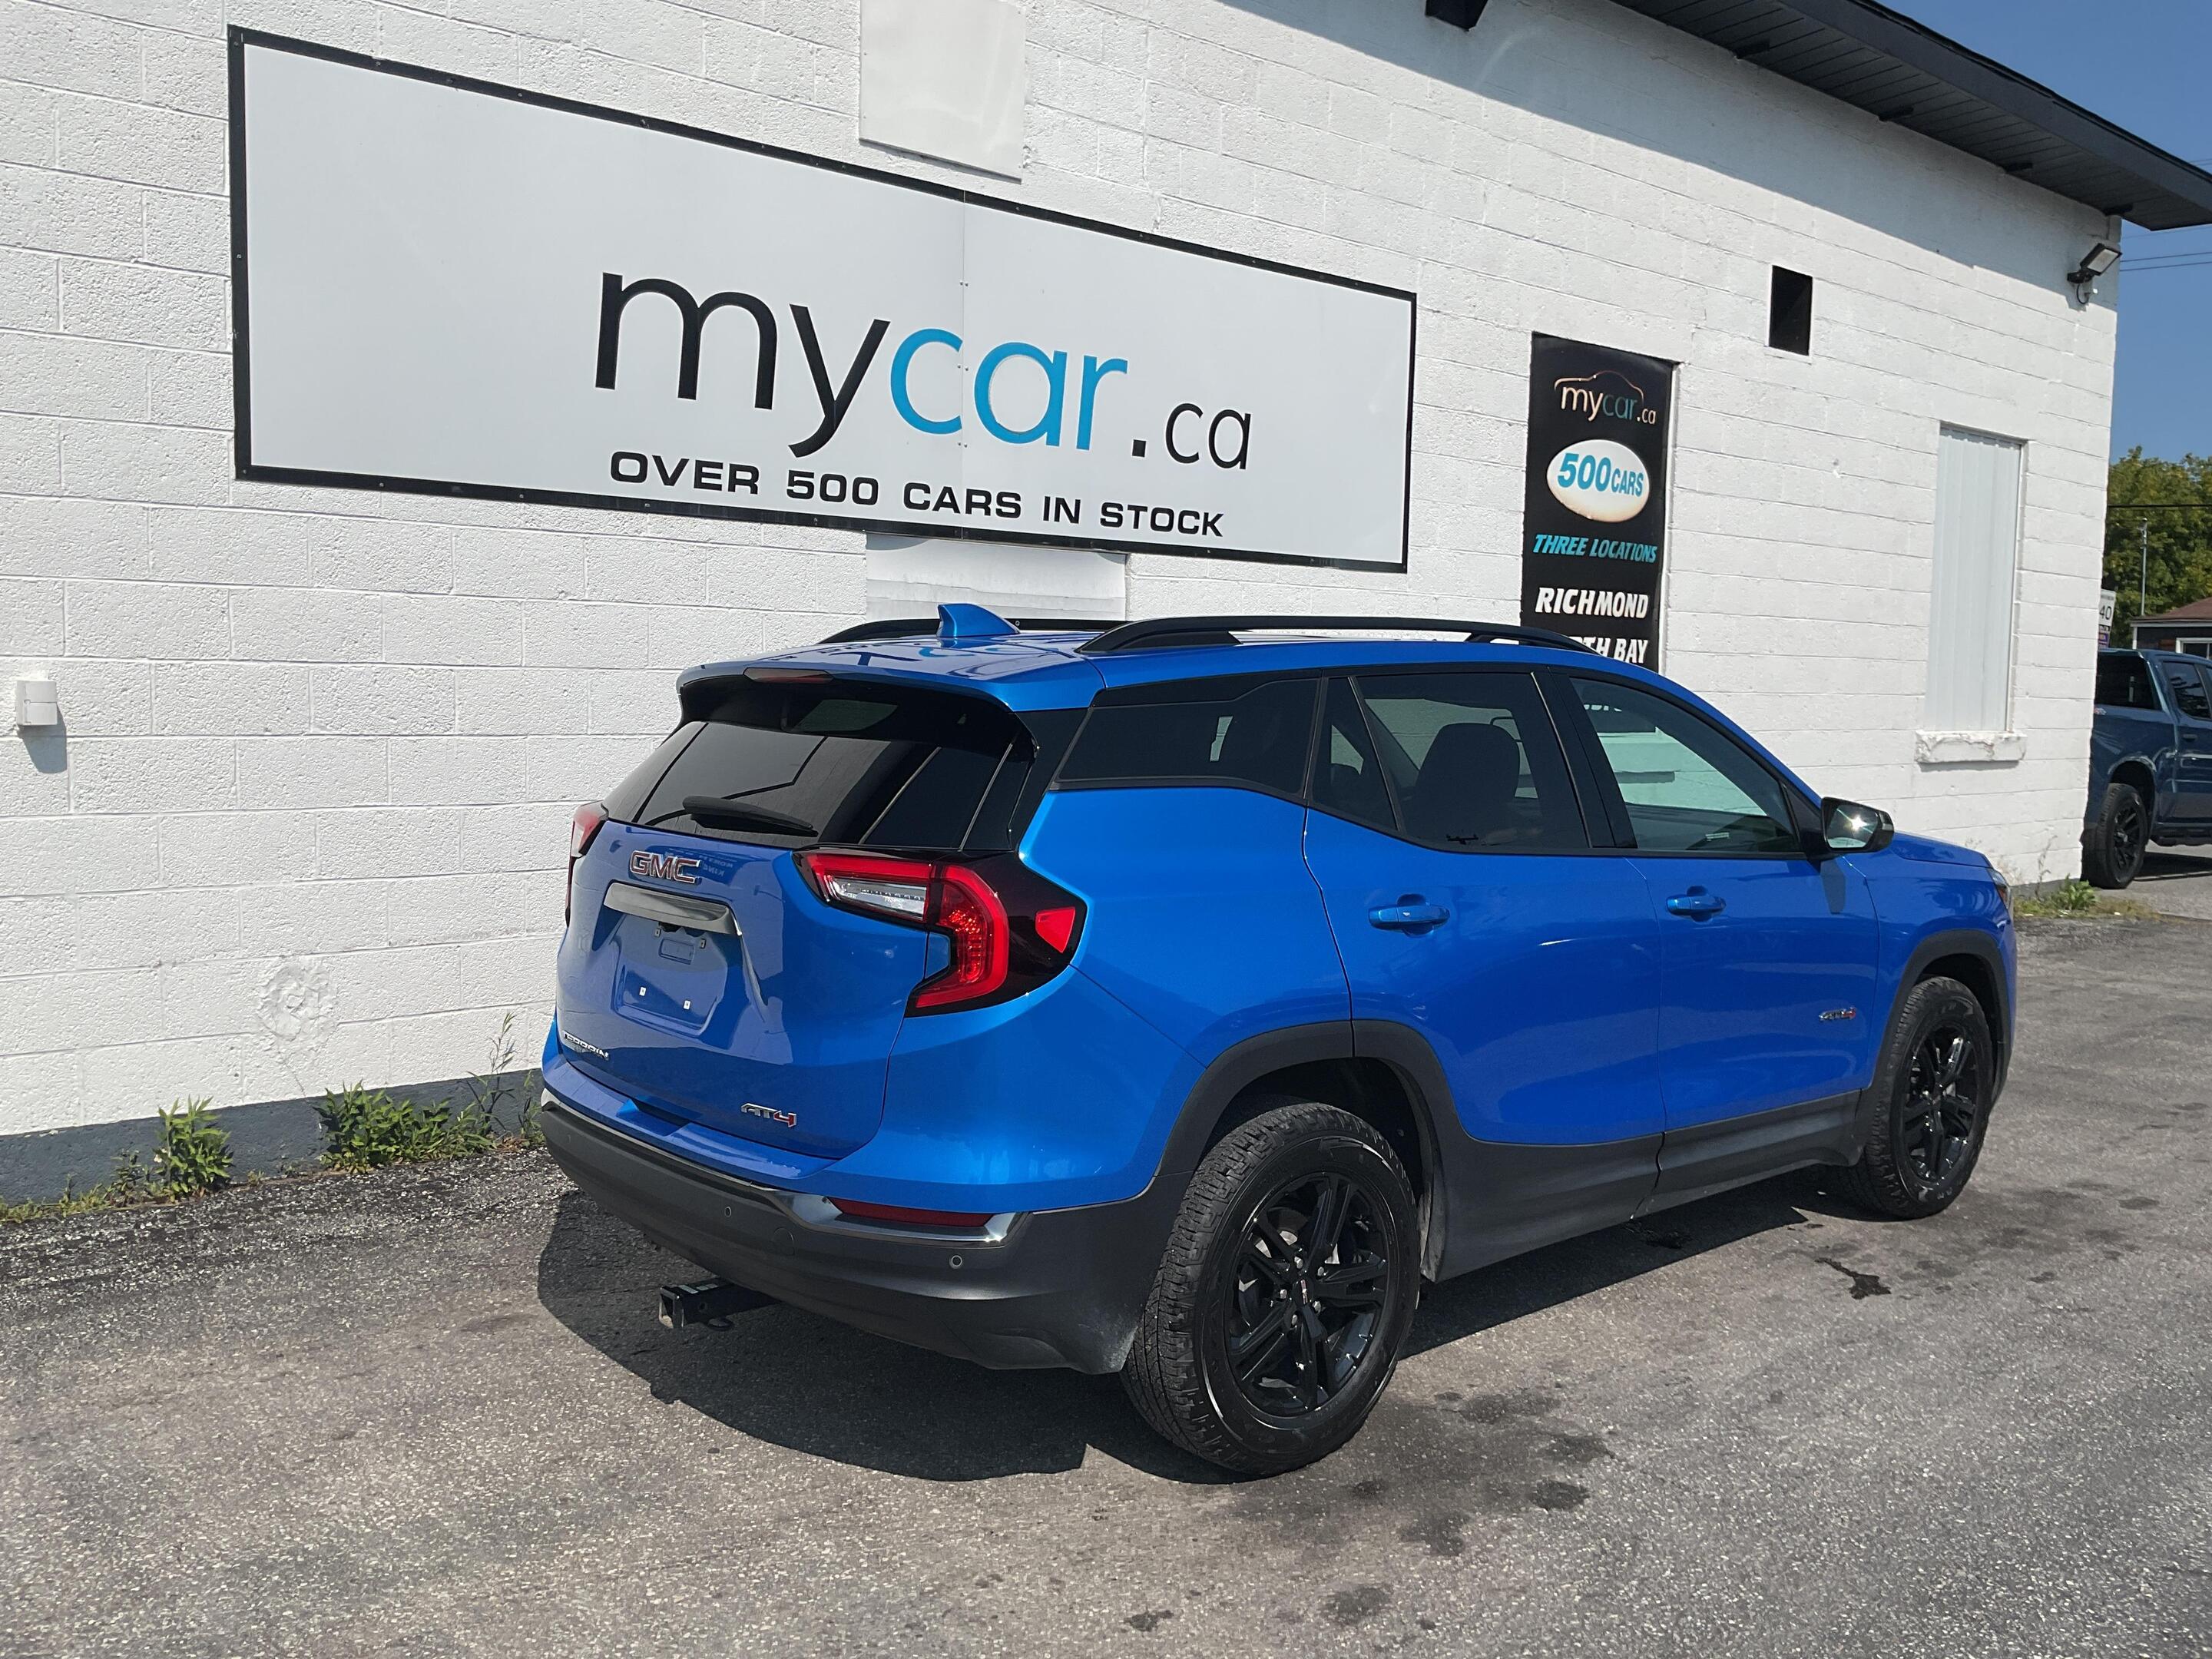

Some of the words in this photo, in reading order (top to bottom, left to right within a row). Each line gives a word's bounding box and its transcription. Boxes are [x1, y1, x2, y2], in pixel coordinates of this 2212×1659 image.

[594, 272, 1252, 470] mycar.ca
[1561, 386, 1657, 425] mycar.ca
[610, 451, 760, 495] OVER
[786, 471, 879, 506] 500
[902, 482, 1022, 518] CARS
[1042, 495, 1081, 525] IN
[1099, 502, 1224, 538] STOCK
[1533, 534, 1588, 556] THREE
[1589, 538, 1657, 563] LOCATIONS
[1535, 587, 1649, 619] RICHMOND
[2099, 605, 2112, 620] 40
[1614, 638, 1648, 664] BAY
[630, 849, 701, 884] GMC
[740, 1103, 796, 1128] AT4
